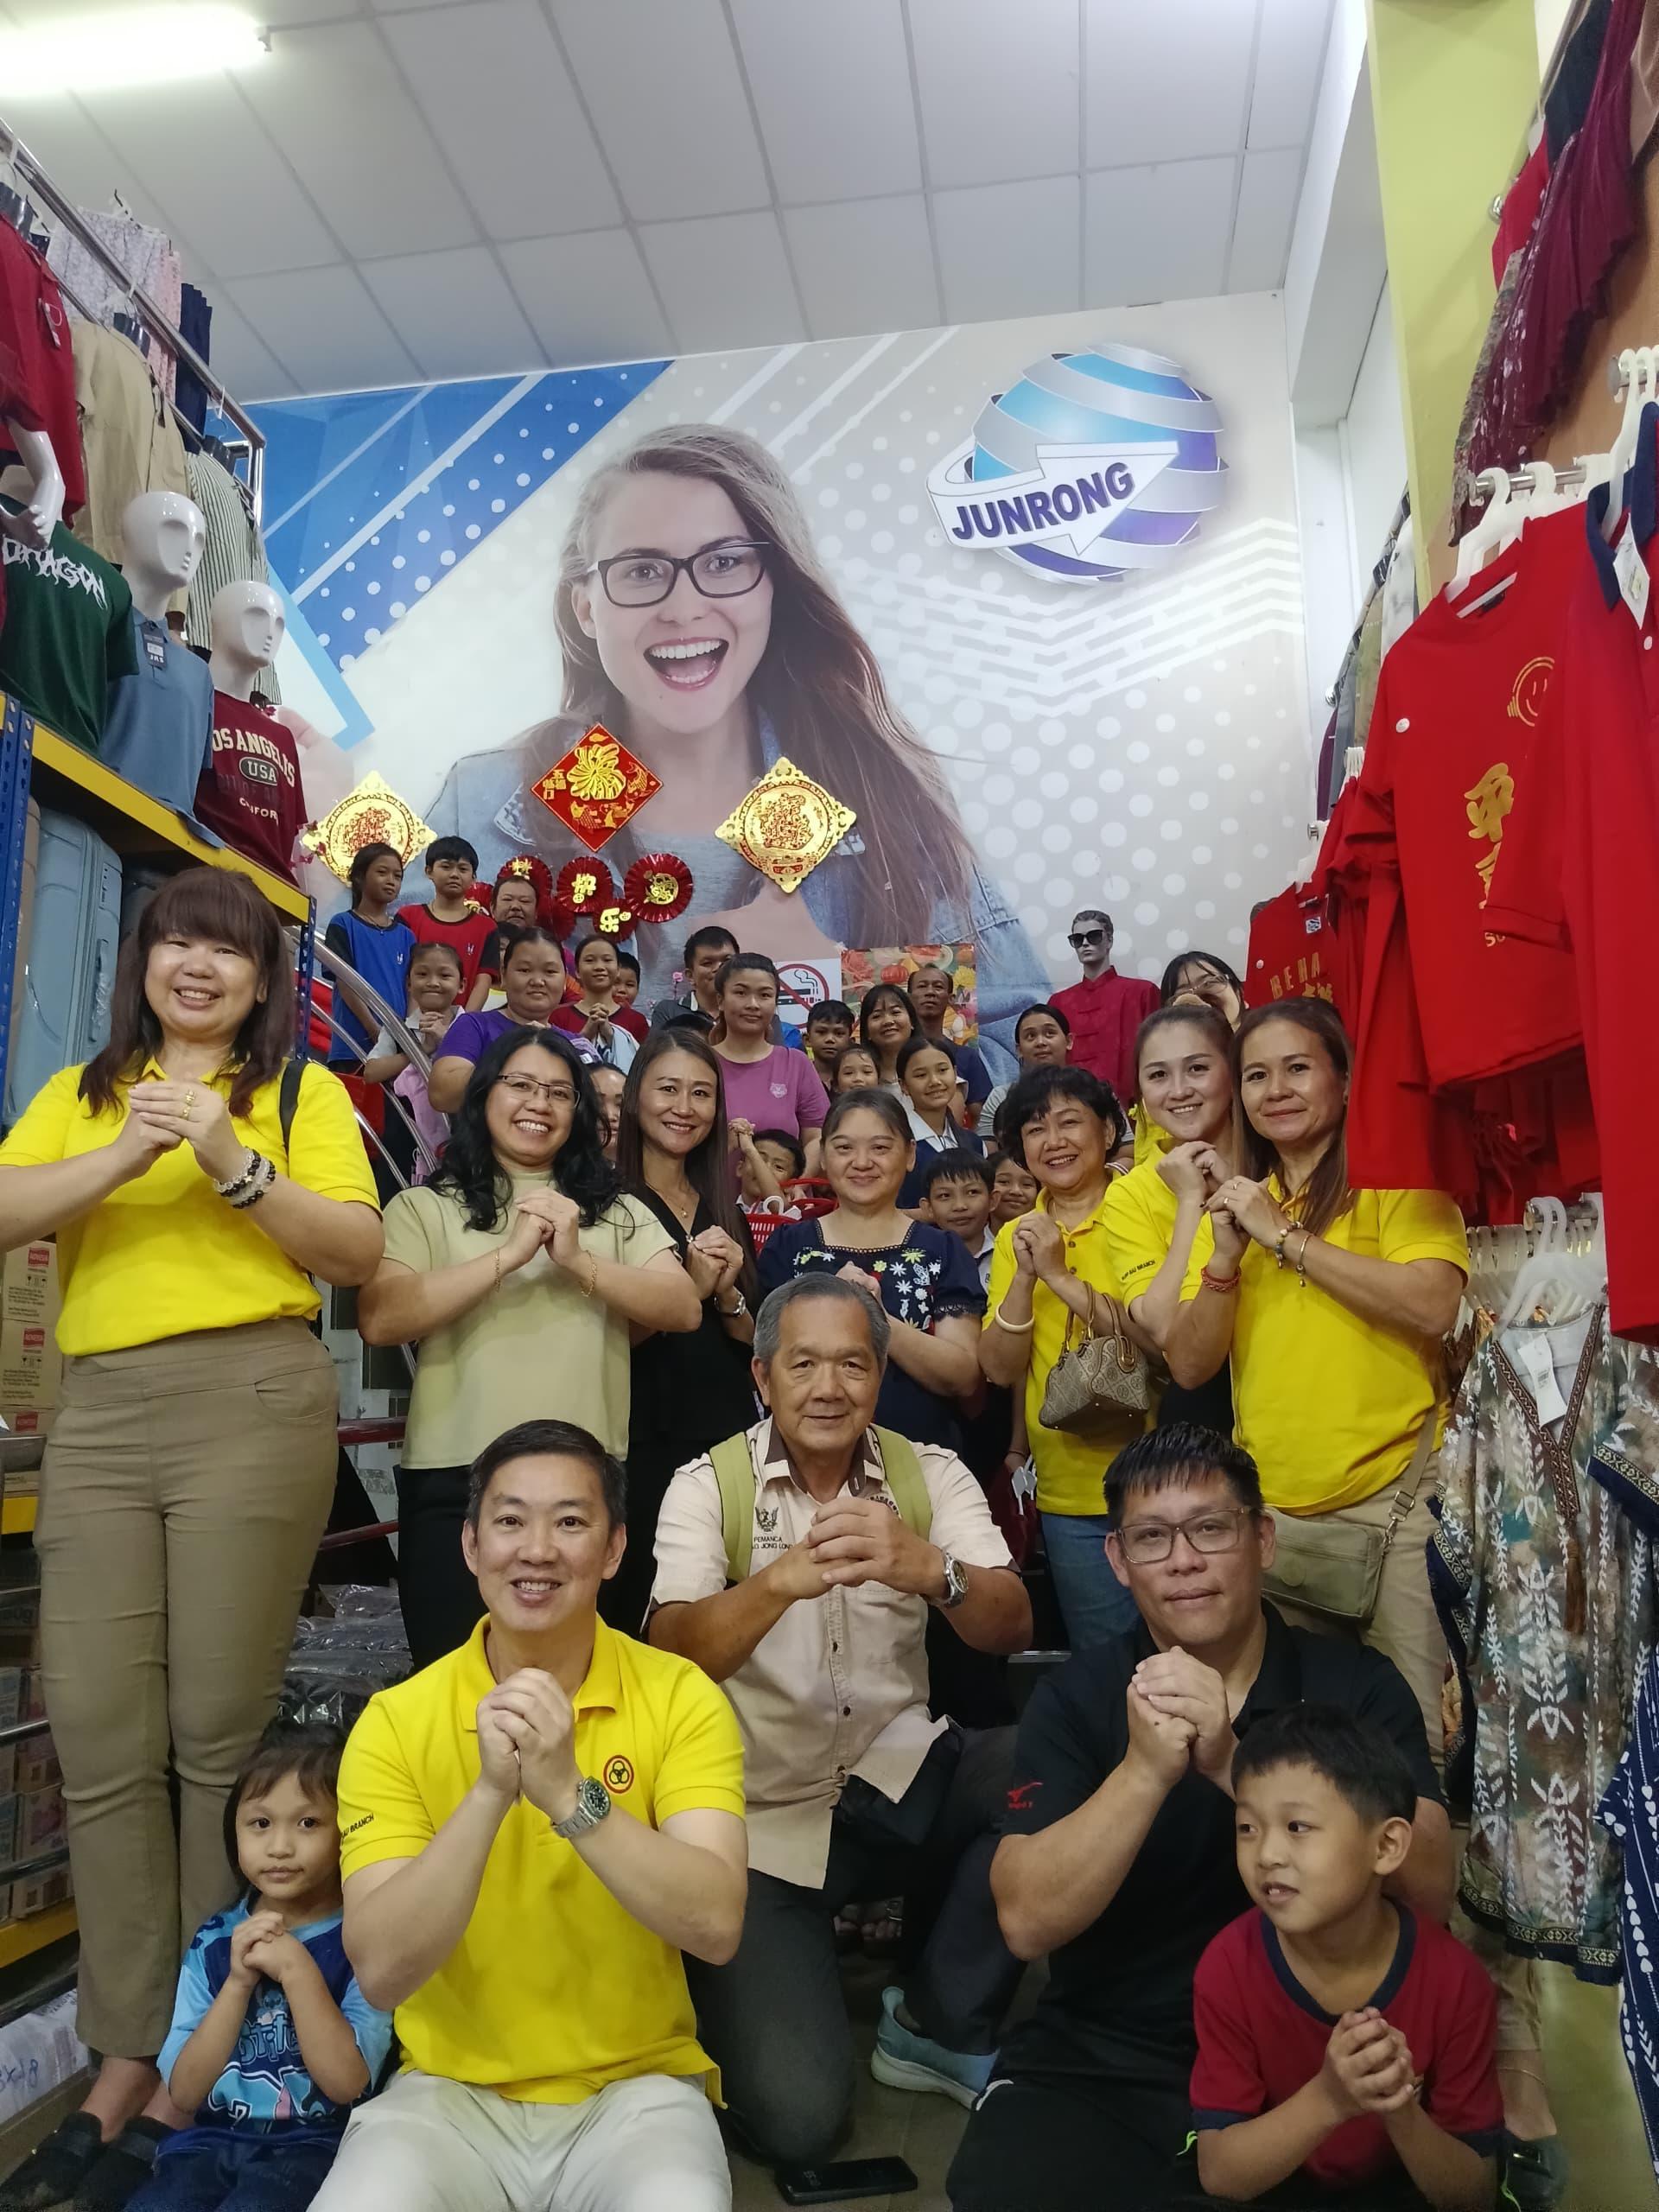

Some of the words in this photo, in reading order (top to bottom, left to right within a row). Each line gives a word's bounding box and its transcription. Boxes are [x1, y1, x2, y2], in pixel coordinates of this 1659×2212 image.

[952, 461, 1135, 540] JUNRONG
[212, 728, 234, 752] OS
[247, 760, 277, 783] USA
[1137, 1260, 1155, 1270] BRANCH
[350, 1812, 374, 1833] BRANCH
